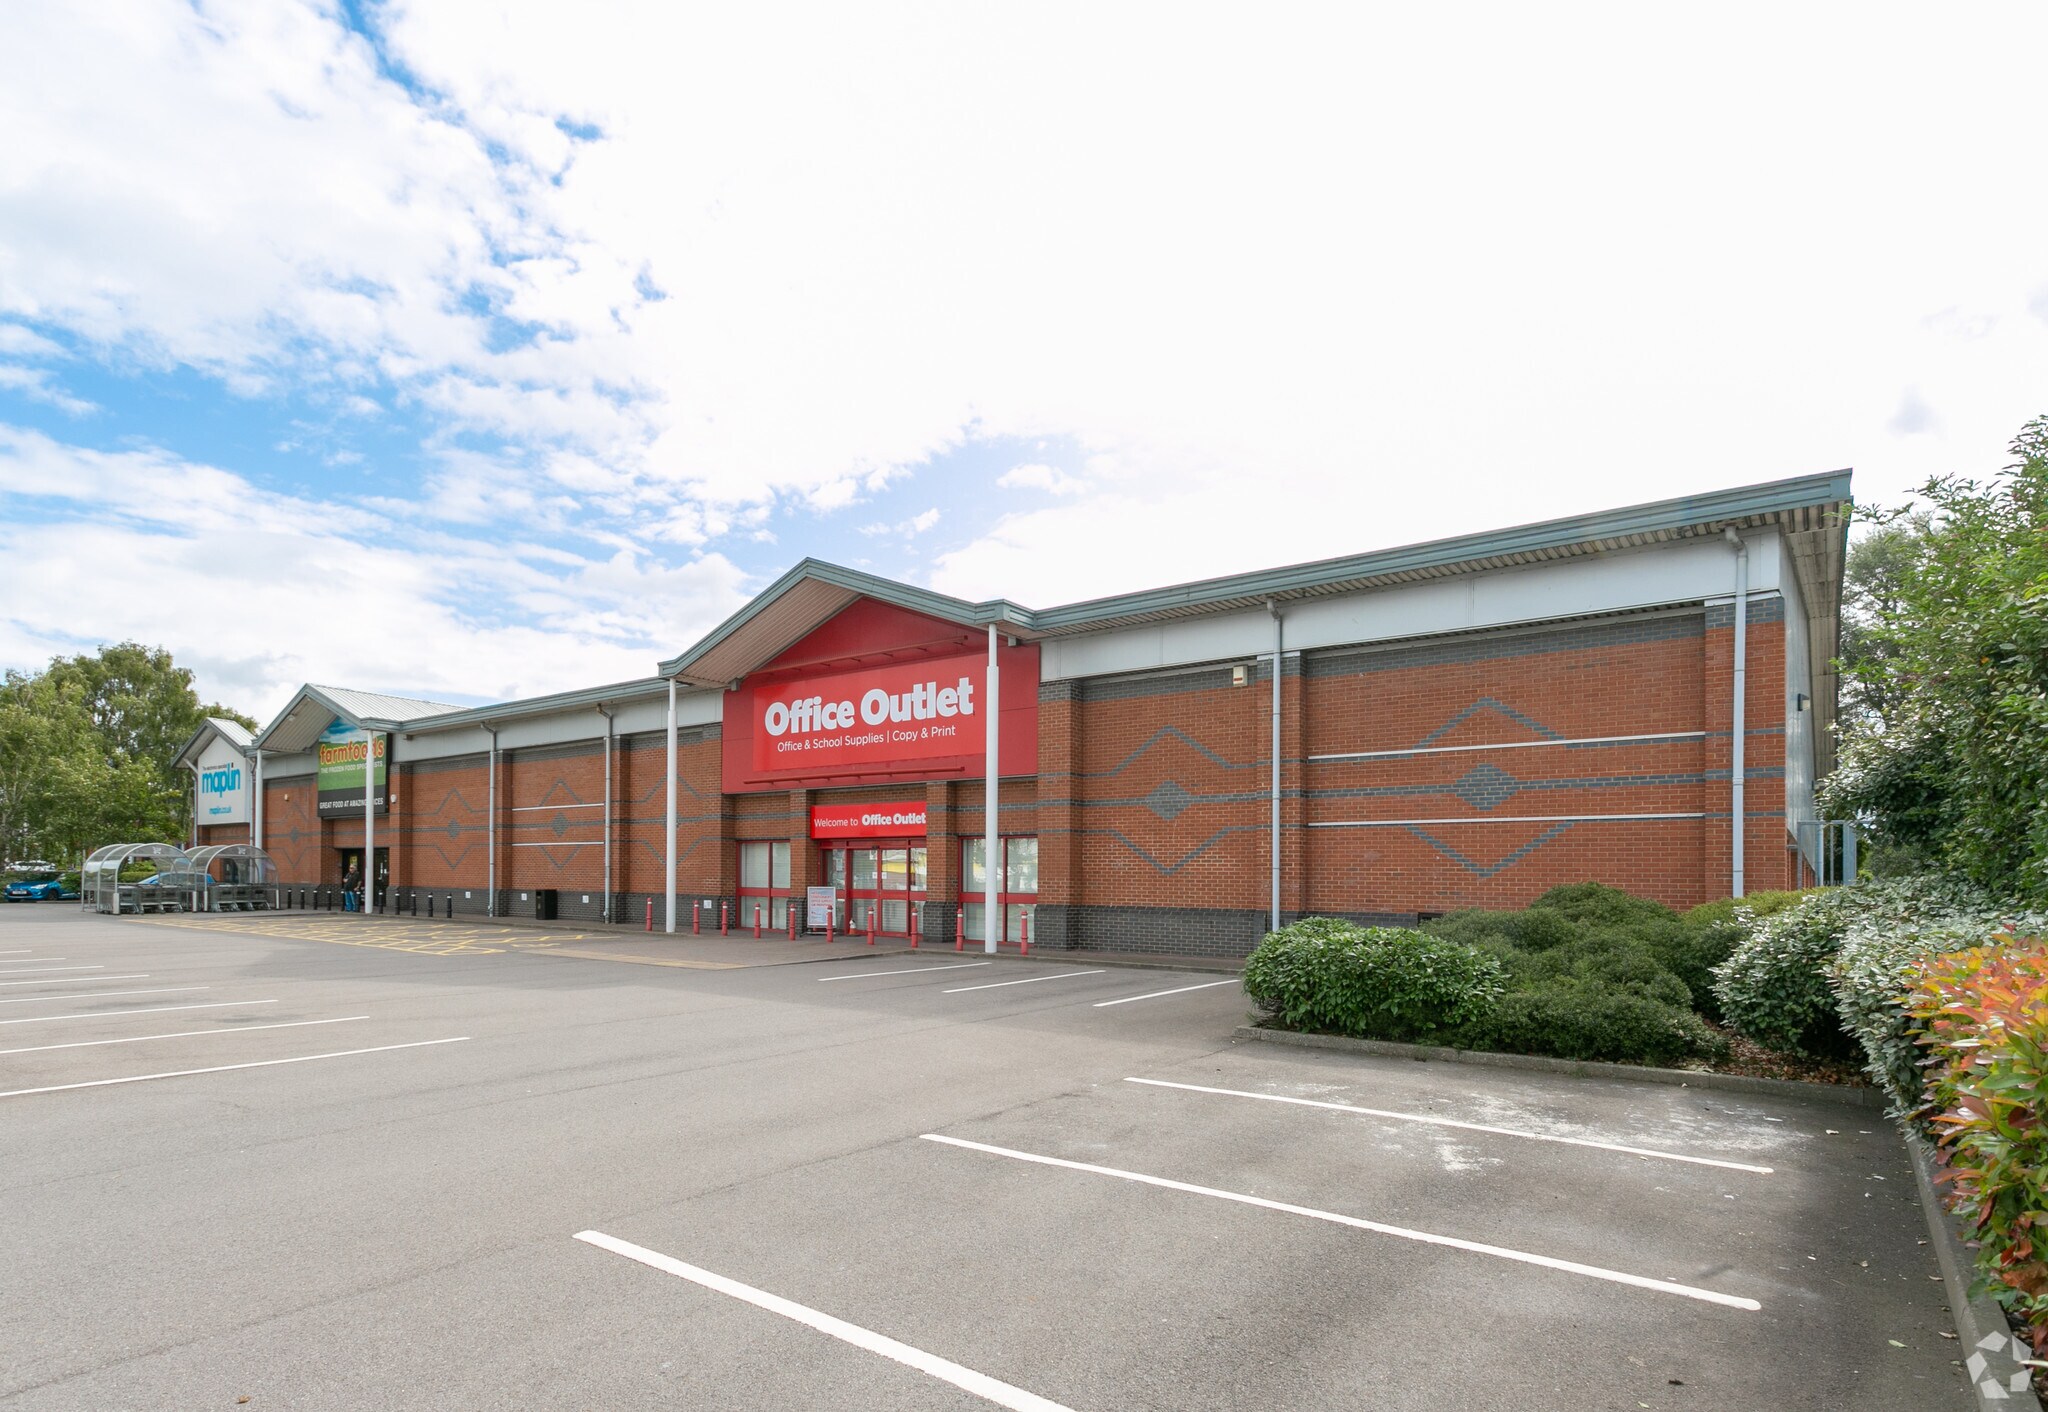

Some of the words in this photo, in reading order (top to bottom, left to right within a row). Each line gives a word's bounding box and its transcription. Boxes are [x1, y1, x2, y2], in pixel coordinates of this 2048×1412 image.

[765, 696, 855, 736] Office
[860, 677, 974, 726] Outlet
[777, 740, 803, 752] Office
[804, 739, 811, 749] &
[812, 736, 843, 748] School
[844, 733, 884, 746] Supplies
[892, 730, 918, 742] Copy
[921, 727, 928, 739] &
[931, 725, 956, 737] Print
[202, 762, 241, 798] maplin
[319, 801, 332, 809] GREAT
[332, 800, 344, 808] FOOD
[814, 818, 848, 827] Welcome
[850, 818, 858, 826] to
[861, 814, 892, 825] Office
[893, 812, 926, 825] Outlet
